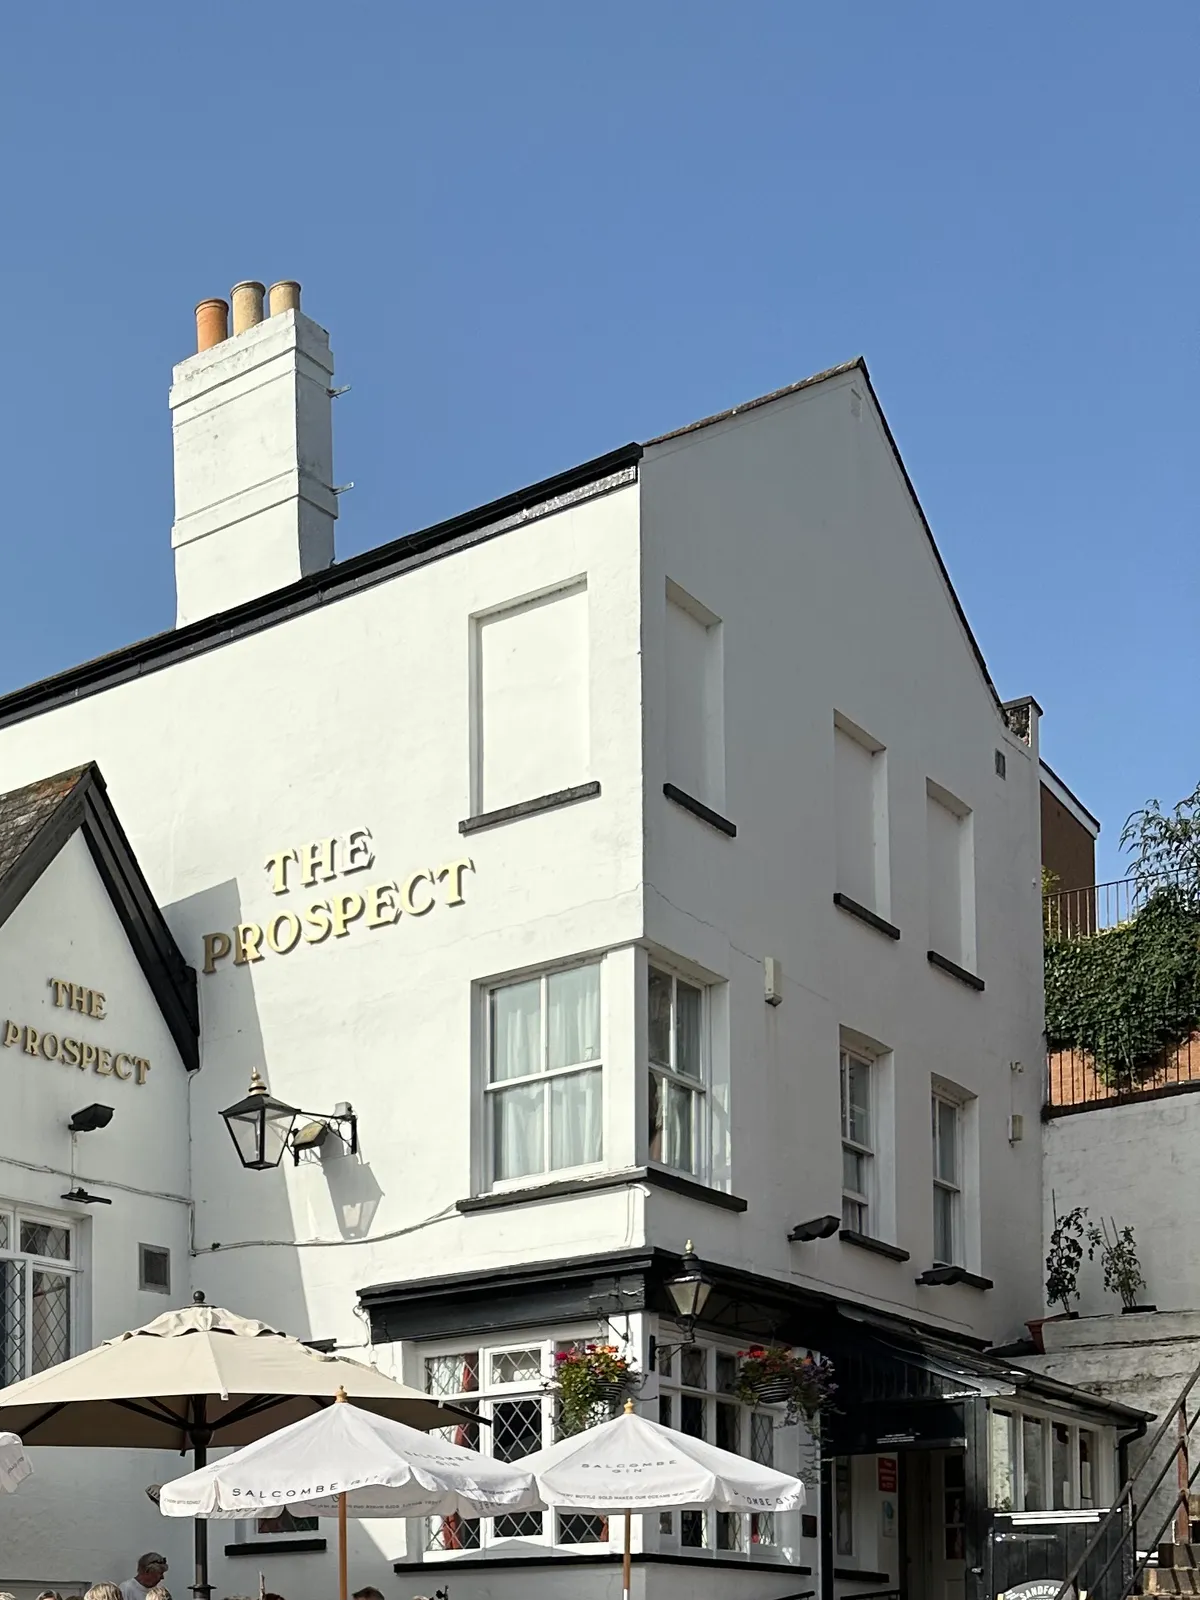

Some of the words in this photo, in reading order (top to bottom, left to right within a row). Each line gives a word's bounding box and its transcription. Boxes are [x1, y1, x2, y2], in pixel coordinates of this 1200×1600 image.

[264, 826, 376, 896] THE
[202, 857, 476, 974] PROSPECT
[47, 977, 108, 1020] THE
[3, 1020, 151, 1085] PROSPECT
[232, 1482, 339, 1499] SALCOMBE
[581, 1459, 678, 1468] SALCOMBE
